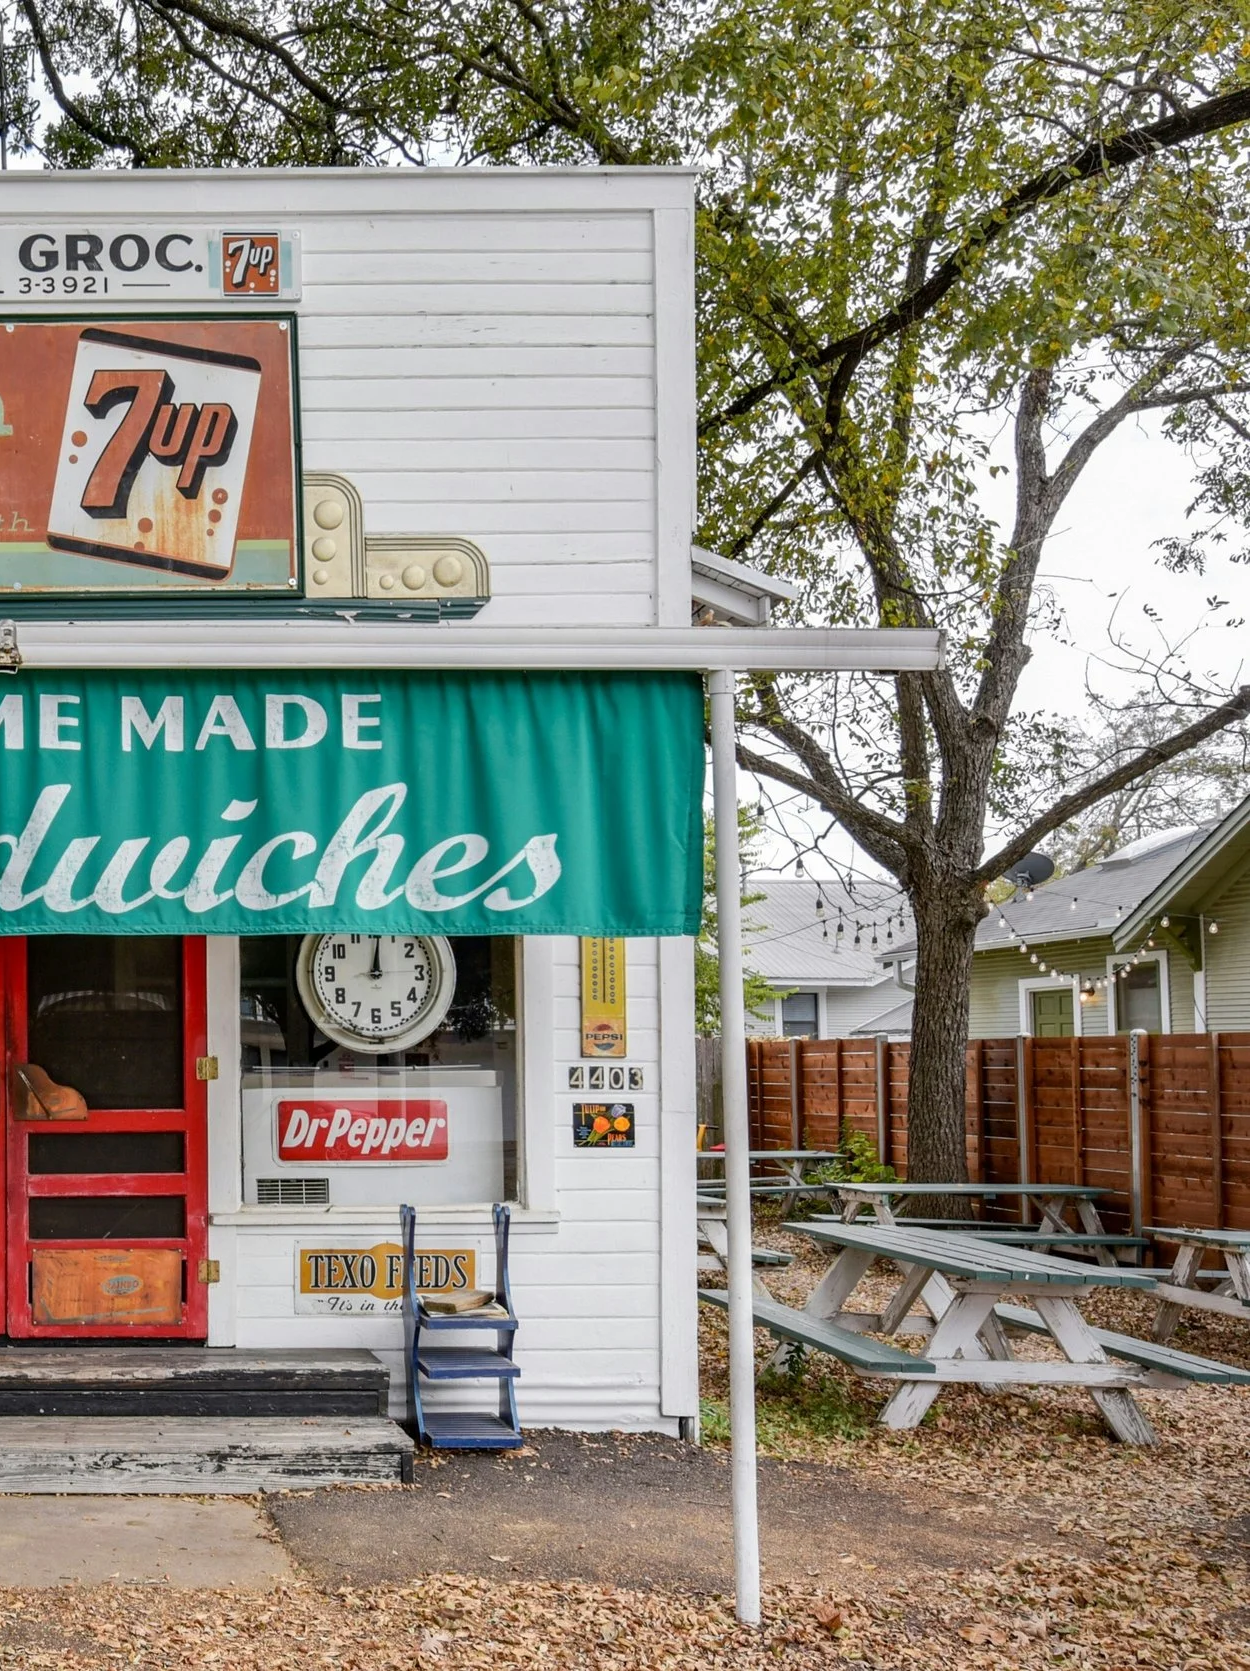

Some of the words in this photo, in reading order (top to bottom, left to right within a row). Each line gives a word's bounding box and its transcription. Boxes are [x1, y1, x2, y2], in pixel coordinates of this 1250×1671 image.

[18, 233, 203, 273] GROC.
[19, 276, 108, 294] 3-3921
[121, 693, 382, 752] MADE
[333, 944, 346, 959] 10
[404, 943, 415, 958] 2
[324, 966, 335, 982] 9
[414, 965, 425, 981] 3
[335, 987, 345, 1004] 8
[407, 987, 417, 1003] 4
[352, 1001, 361, 1018] 7
[371, 1008, 381, 1024] 6
[391, 1001, 402, 1017] 5
[585, 1033, 623, 1041] PEPSI
[569, 1066, 643, 1089] 4403
[307, 1255, 377, 1289] TEXO
[385, 1255, 468, 1289] FEDS
[360, 1299, 375, 1311] in
